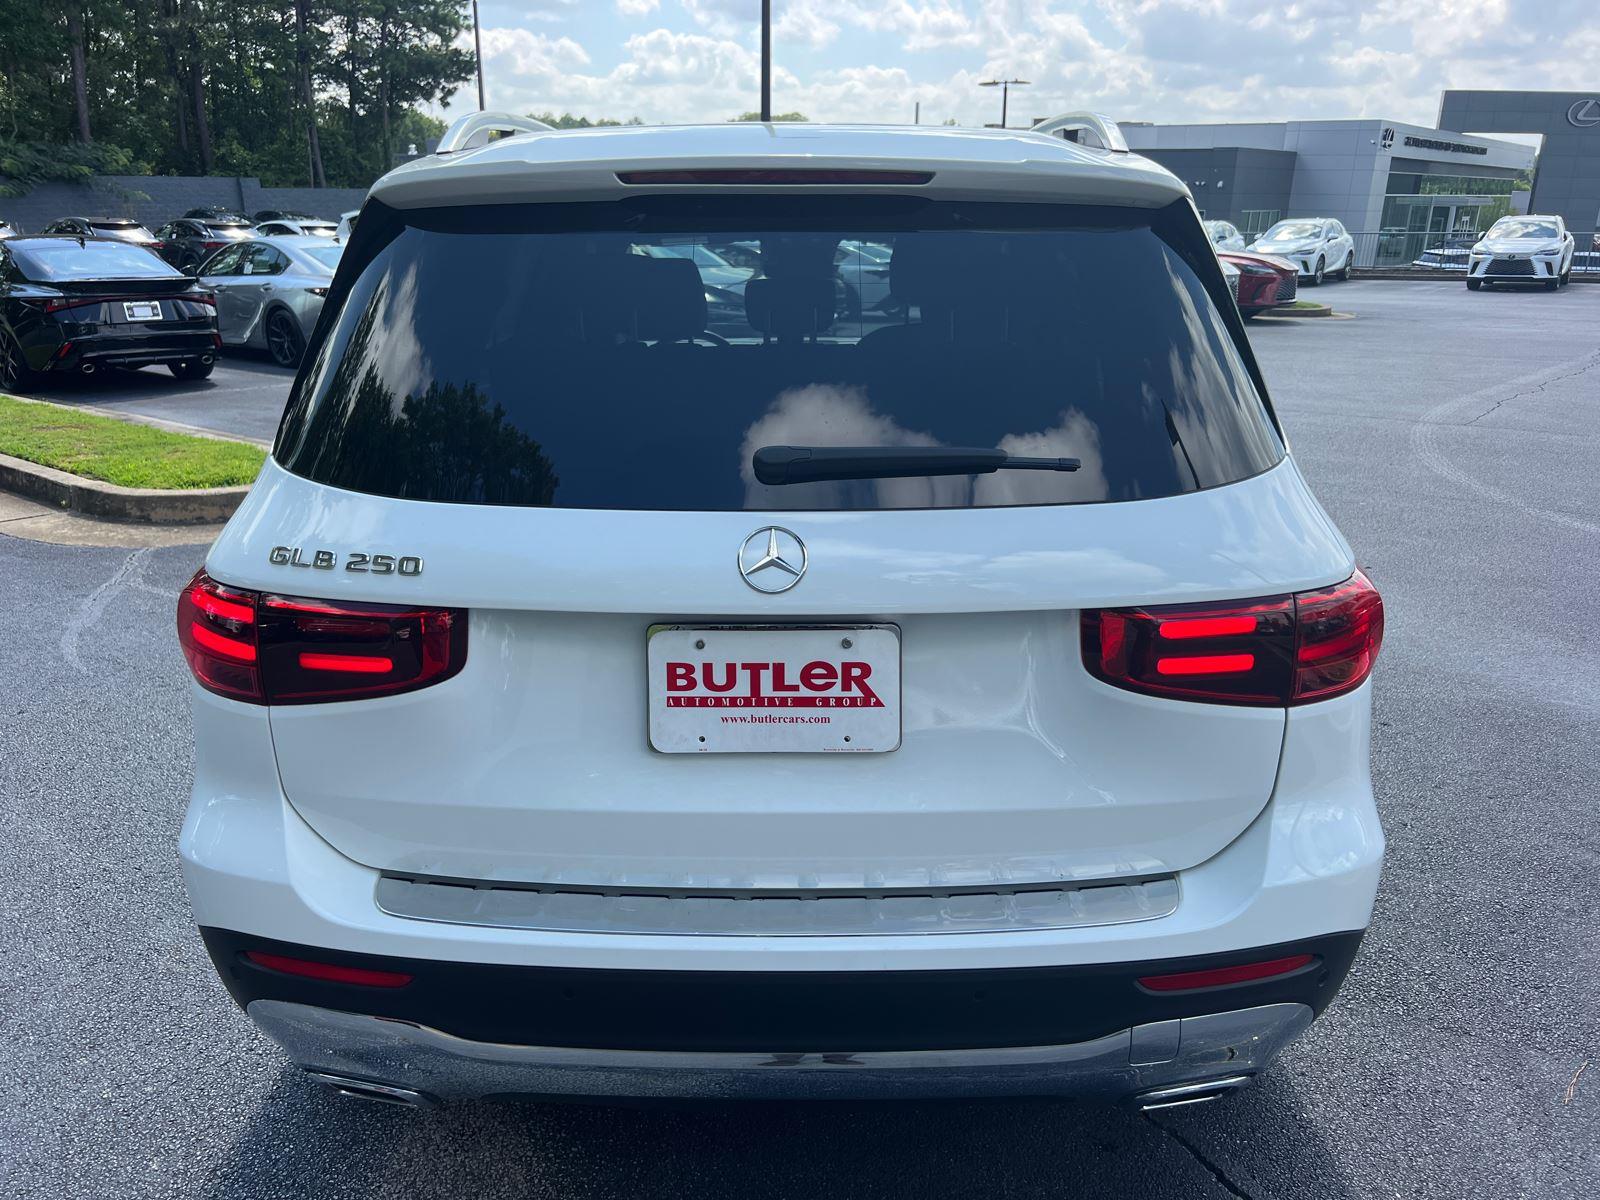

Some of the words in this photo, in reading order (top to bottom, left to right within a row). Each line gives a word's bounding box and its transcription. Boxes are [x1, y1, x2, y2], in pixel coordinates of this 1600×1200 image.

[269, 546, 337, 570] GLB
[345, 552, 424, 576] 250
[667, 697, 794, 707] AUTOMOTIVE
[815, 697, 877, 707] GROUP
[720, 714, 831, 725] www.butlercars.com
